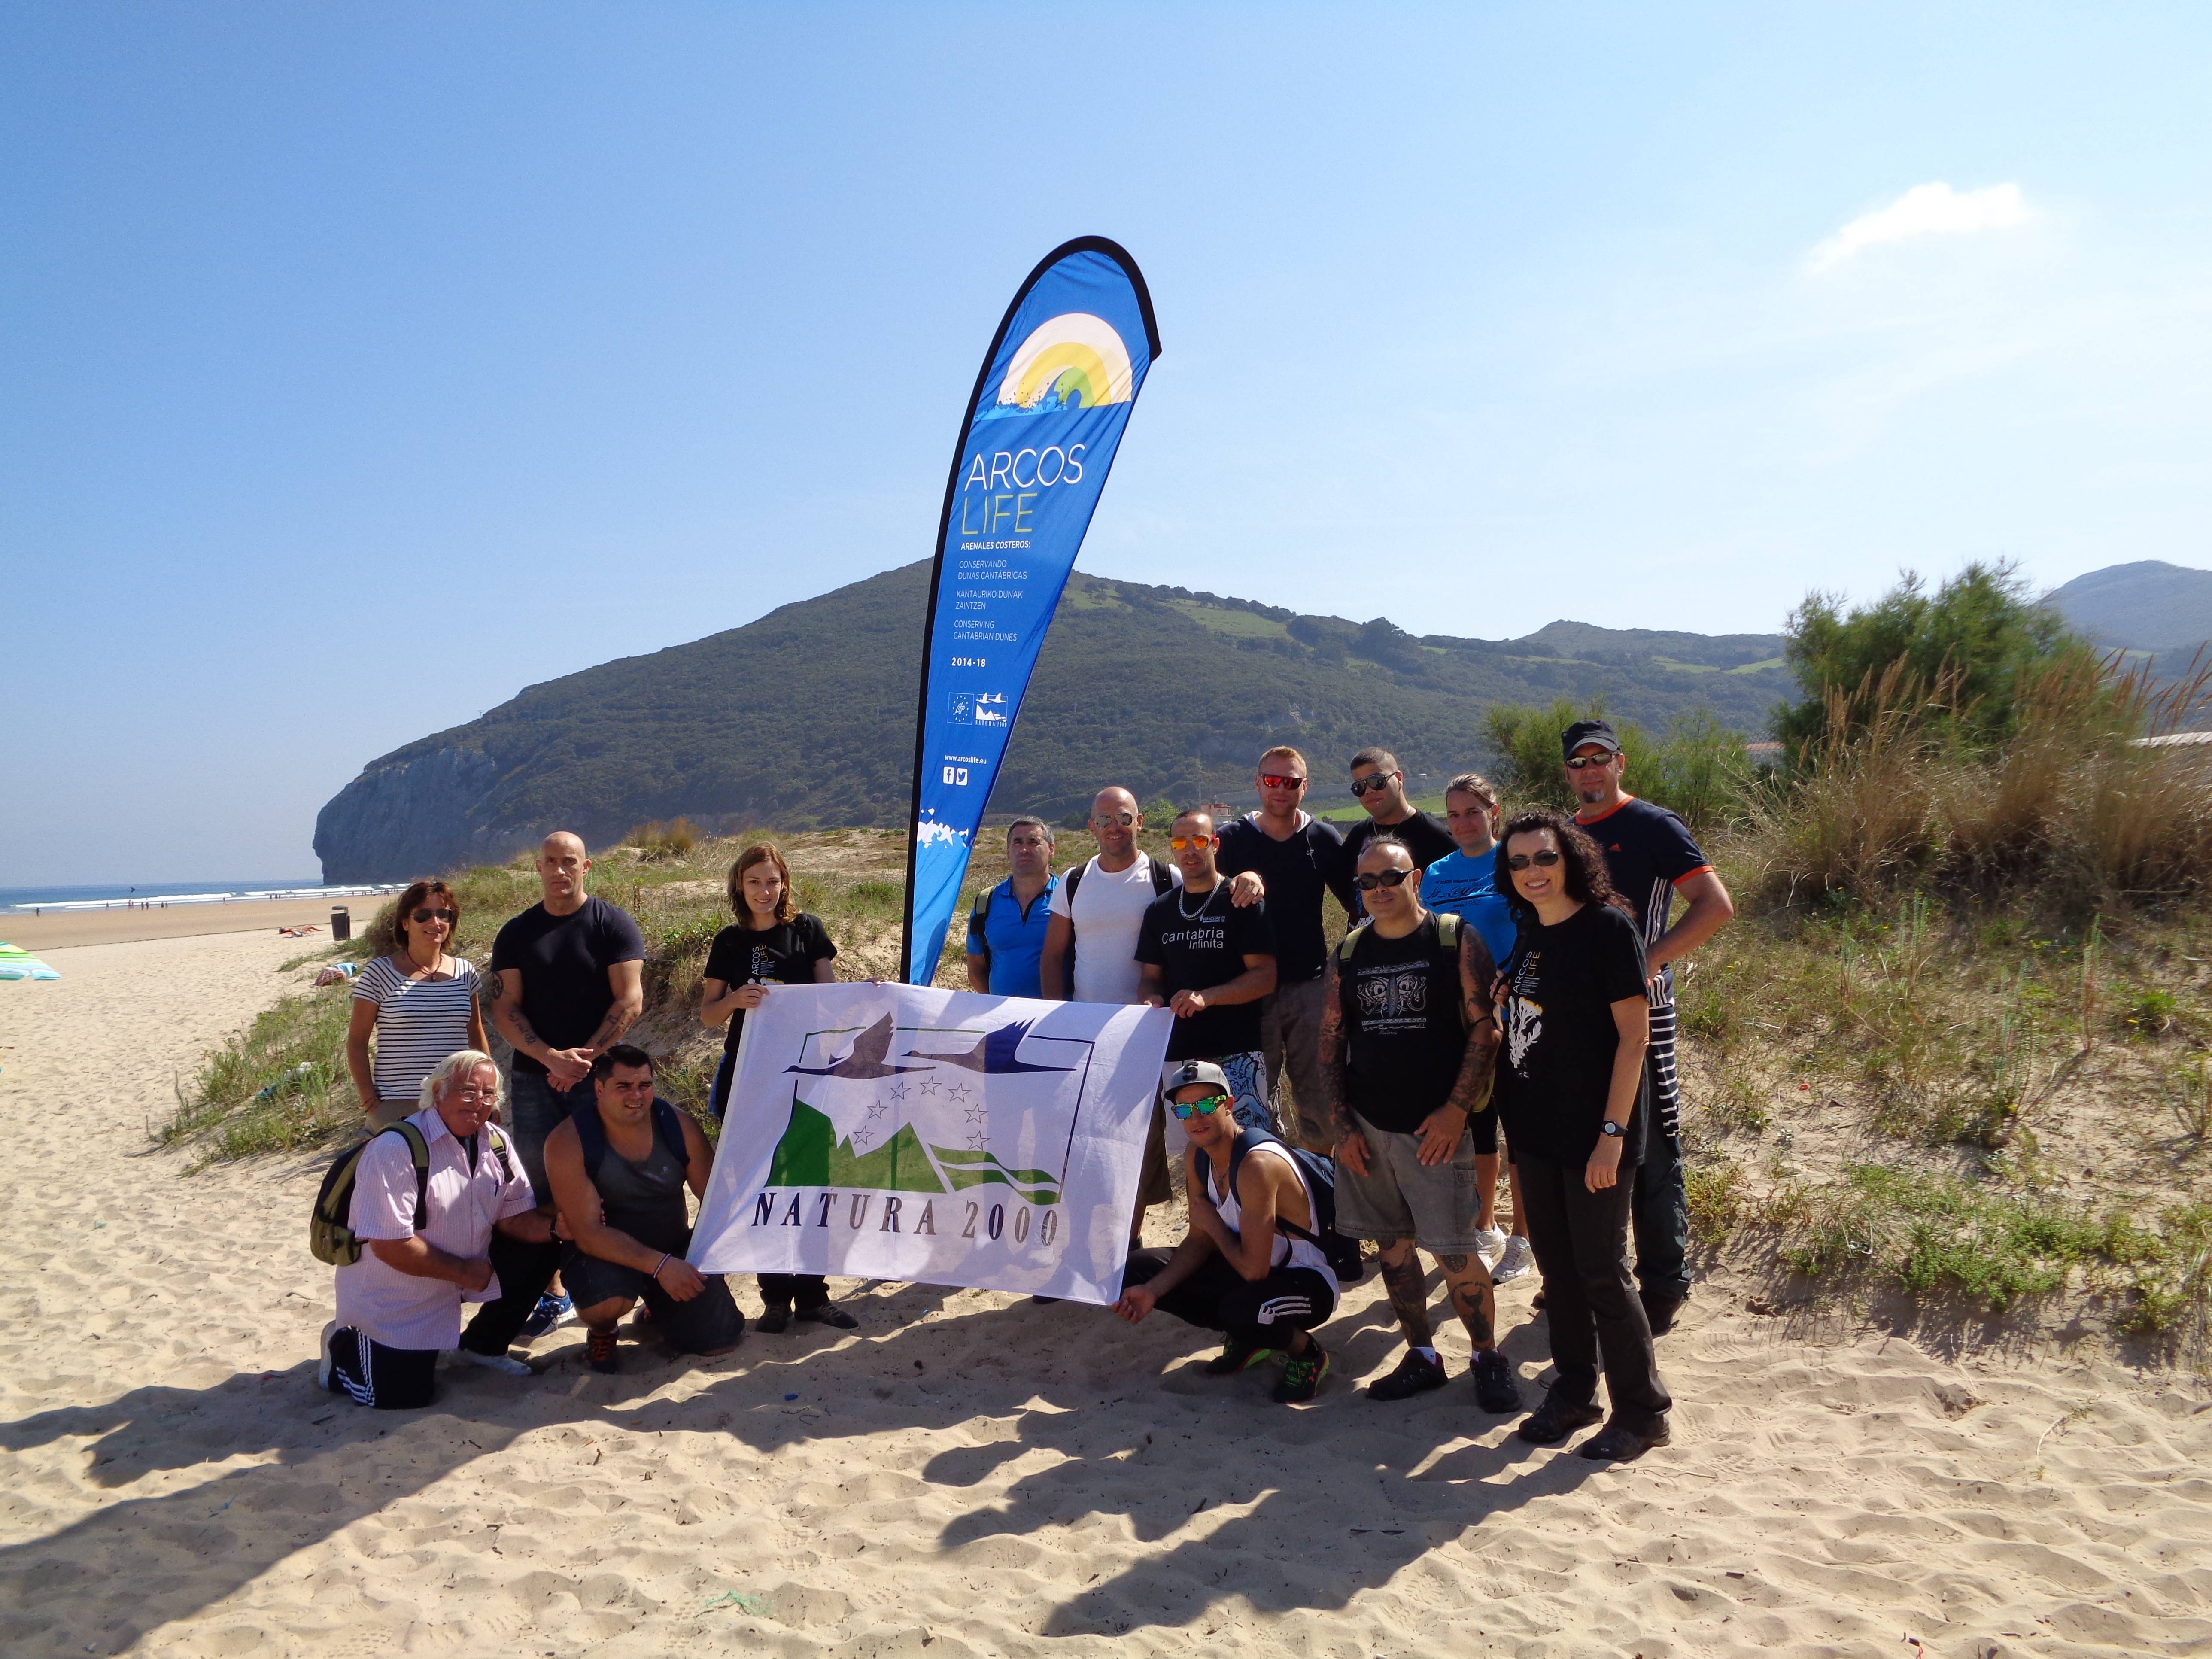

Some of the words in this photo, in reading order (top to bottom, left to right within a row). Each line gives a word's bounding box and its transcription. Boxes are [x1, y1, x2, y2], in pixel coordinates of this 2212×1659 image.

[964, 443, 1086, 492] ARCOS
[962, 492, 1038, 535] LIFE
[960, 541, 994, 550] ARENALES
[995, 540, 1031, 549] COSTEROS:
[959, 559, 1007, 568] CONSERVANDO
[958, 571, 979, 580] DUNAS
[981, 570, 1027, 580] CANTÁBRICAS
[955, 602, 986, 610] ZAINTZEN
[954, 620, 994, 629] CONSERVING
[953, 631, 994, 640] CANTABRIAN
[995, 633, 1017, 641] DUNES
[951, 657, 986, 667] 2014-18
[945, 754, 987, 764] www.arcoslife.eu
[1162, 927, 1224, 945] Cantabria
[1188, 939, 1224, 949] Infinita
[759, 945, 768, 963] LIFE
[751, 946, 760, 975] ARCOS
[1525, 952, 1540, 977] LIFE
[1513, 951, 1532, 994] ARCOS
[751, 1192, 937, 1235] NATURA
[961, 1200, 1058, 1246] 2000
